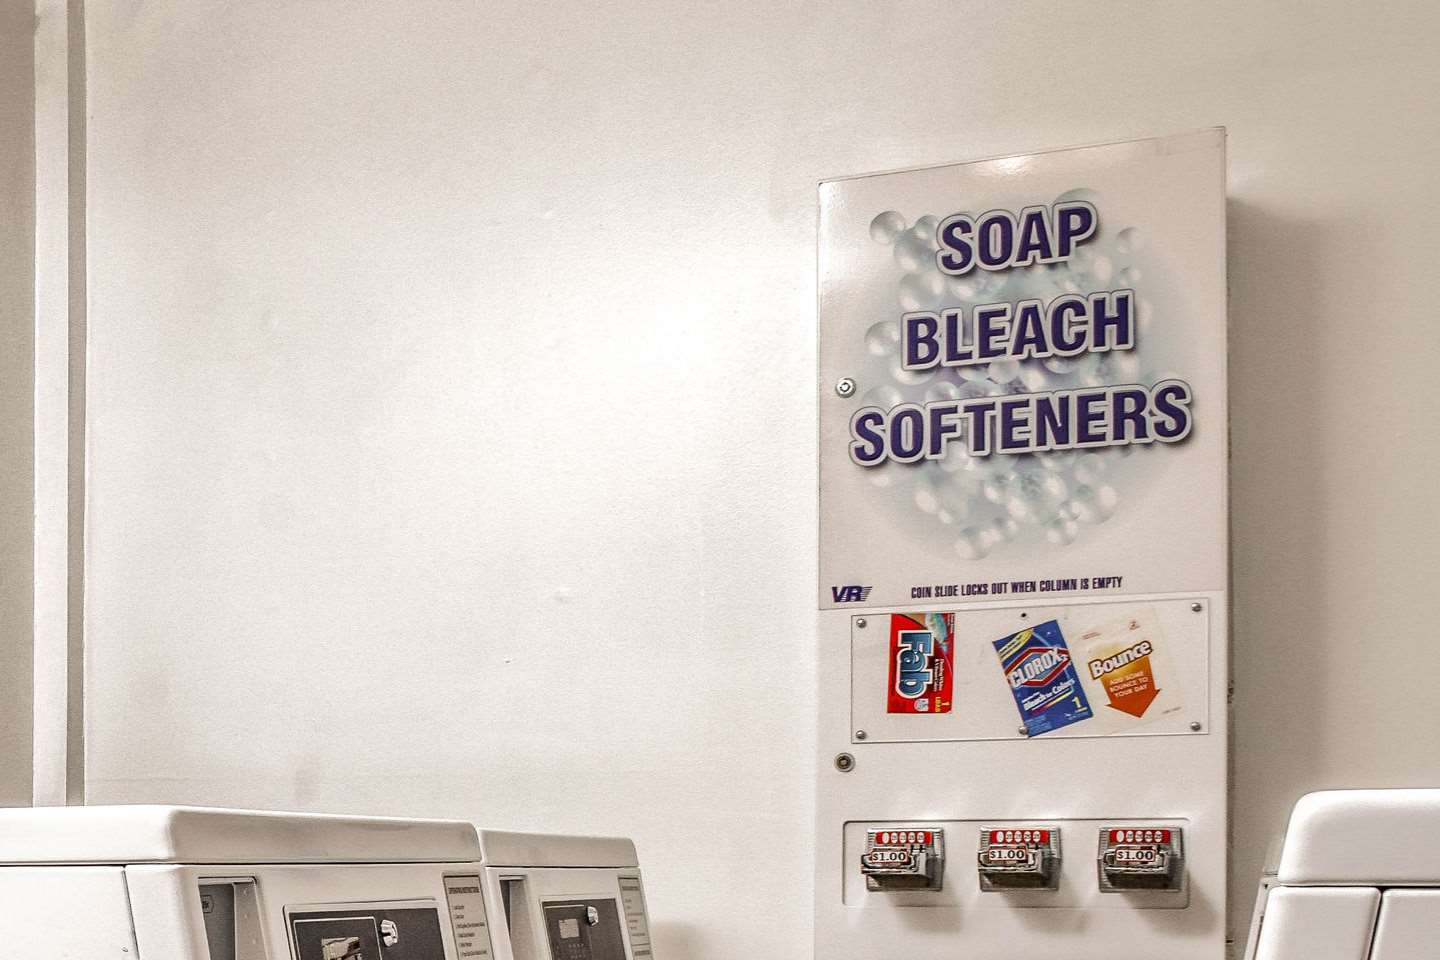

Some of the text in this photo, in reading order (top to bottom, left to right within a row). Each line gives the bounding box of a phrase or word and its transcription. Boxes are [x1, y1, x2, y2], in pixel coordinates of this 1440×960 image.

[939, 204, 1095, 273] SOAP
[904, 293, 1133, 368] BLEACH
[852, 383, 1190, 464] SOFTENERS
[911, 576, 1123, 599] COIN SLIDE LOCKS OUT WHEN COLUMN IS EMPTY
[897, 631, 933, 697] Fab
[1008, 649, 1062, 689] CLOROX
[1089, 641, 1152, 679] Bounce
[872, 852, 906, 861] $1.00
[990, 850, 1025, 859] $1.00
[1118, 850, 1154, 860] $1.00
